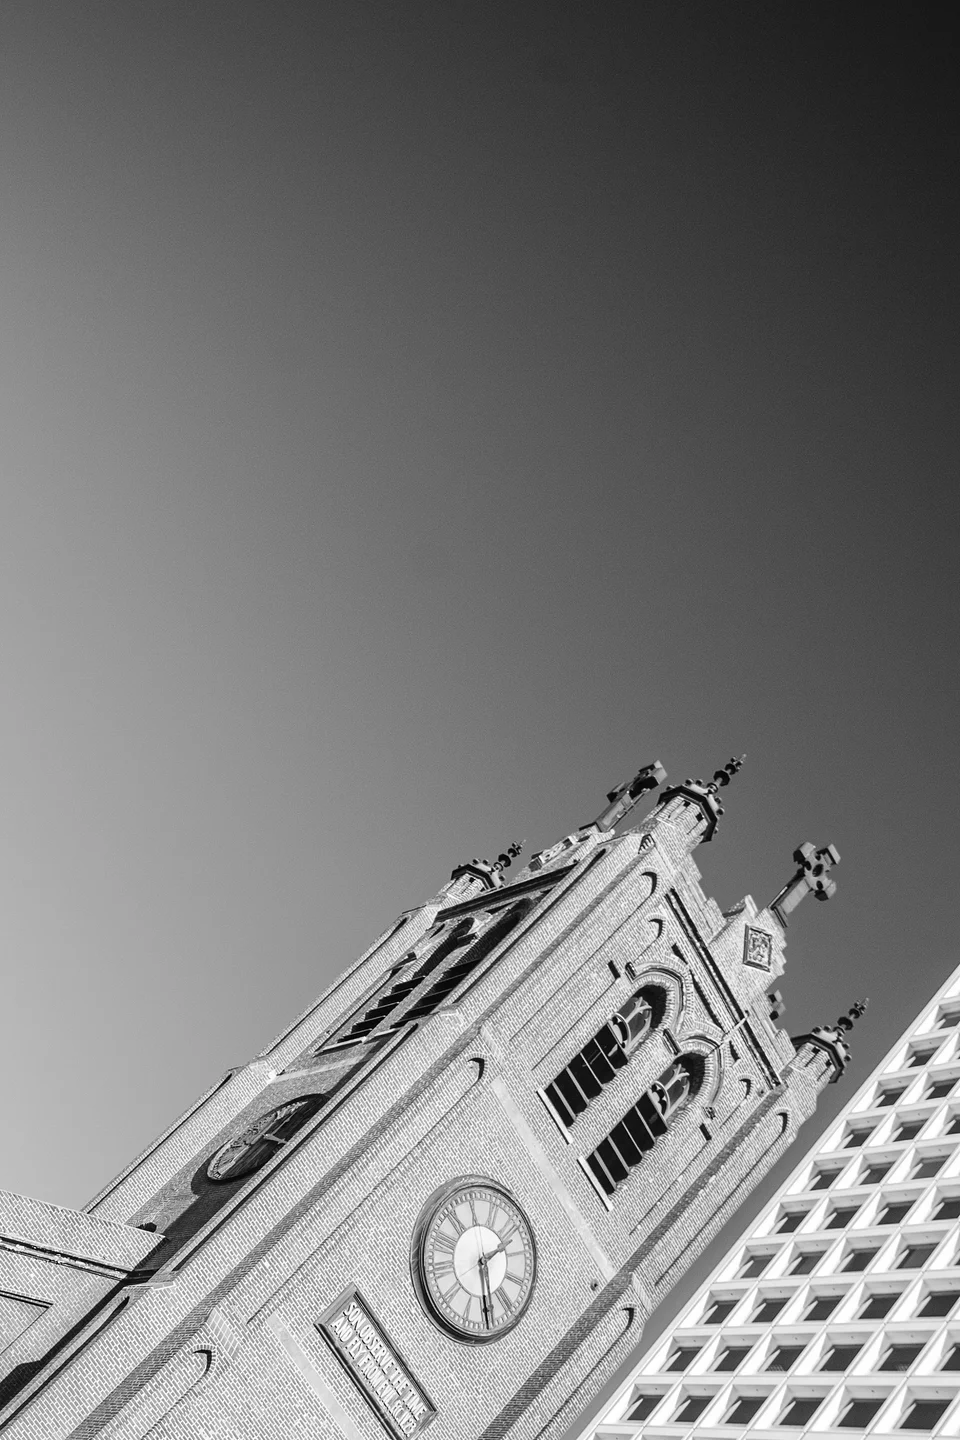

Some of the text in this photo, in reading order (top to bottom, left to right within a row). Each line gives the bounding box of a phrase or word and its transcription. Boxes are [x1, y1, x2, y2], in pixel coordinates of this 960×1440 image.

[331, 1317, 353, 1343] AND
[345, 1337, 367, 1360] FLY
[358, 1356, 385, 1388] FROM
[389, 1368, 409, 1395] THE
[403, 1389, 427, 1421] TIME
